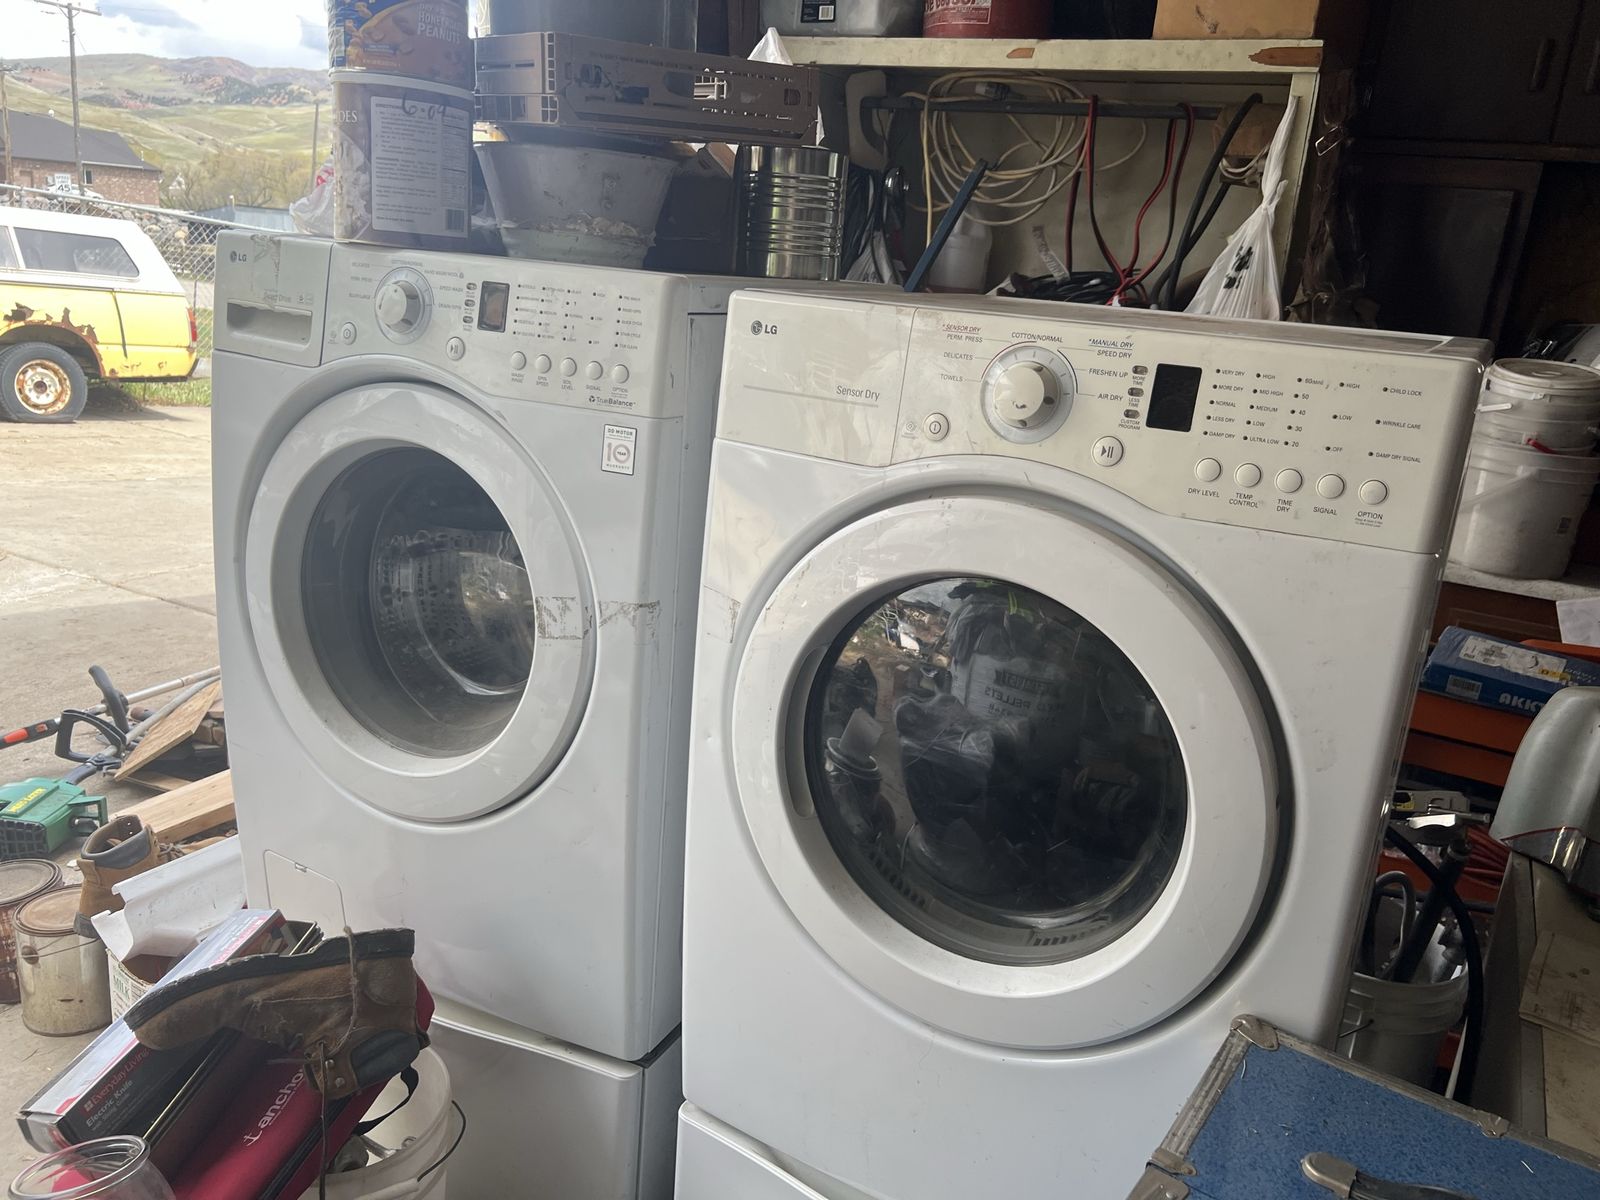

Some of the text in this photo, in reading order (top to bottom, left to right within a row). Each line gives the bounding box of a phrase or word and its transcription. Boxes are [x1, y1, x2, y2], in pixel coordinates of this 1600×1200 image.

[57, 184, 70, 193] 45
[969, 325, 981, 333] DRY
[965, 335, 983, 343] PRESS
[1011, 331, 1063, 343] COTTON/NORMAL
[1120, 341, 1134, 349] DRY
[943, 351, 973, 360] DELICATES
[1097, 349, 1132, 359] SPEED DRY
[1088, 368, 1119, 377] FRESHEN
[940, 373, 963, 382] TOWELS
[836, 385, 880, 401] Sensor Dry
[1389, 387, 1406, 395] CHILD
[1382, 419, 1421, 430] WRINKLE CARE
[1402, 455, 1421, 463] SIGNAL
[1187, 487, 1220, 498] DRY LEVEL
[1235, 492, 1253, 500] TEMP
[1228, 498, 1259, 509] CONTROL
[1277, 498, 1293, 507] TIME
[1276, 505, 1290, 513] DRY
[1313, 506, 1338, 516] SIGNAL
[1357, 510, 1384, 520] OPTION
[86, 1098, 115, 1128] Electric
[113, 1080, 133, 1100] Knife
